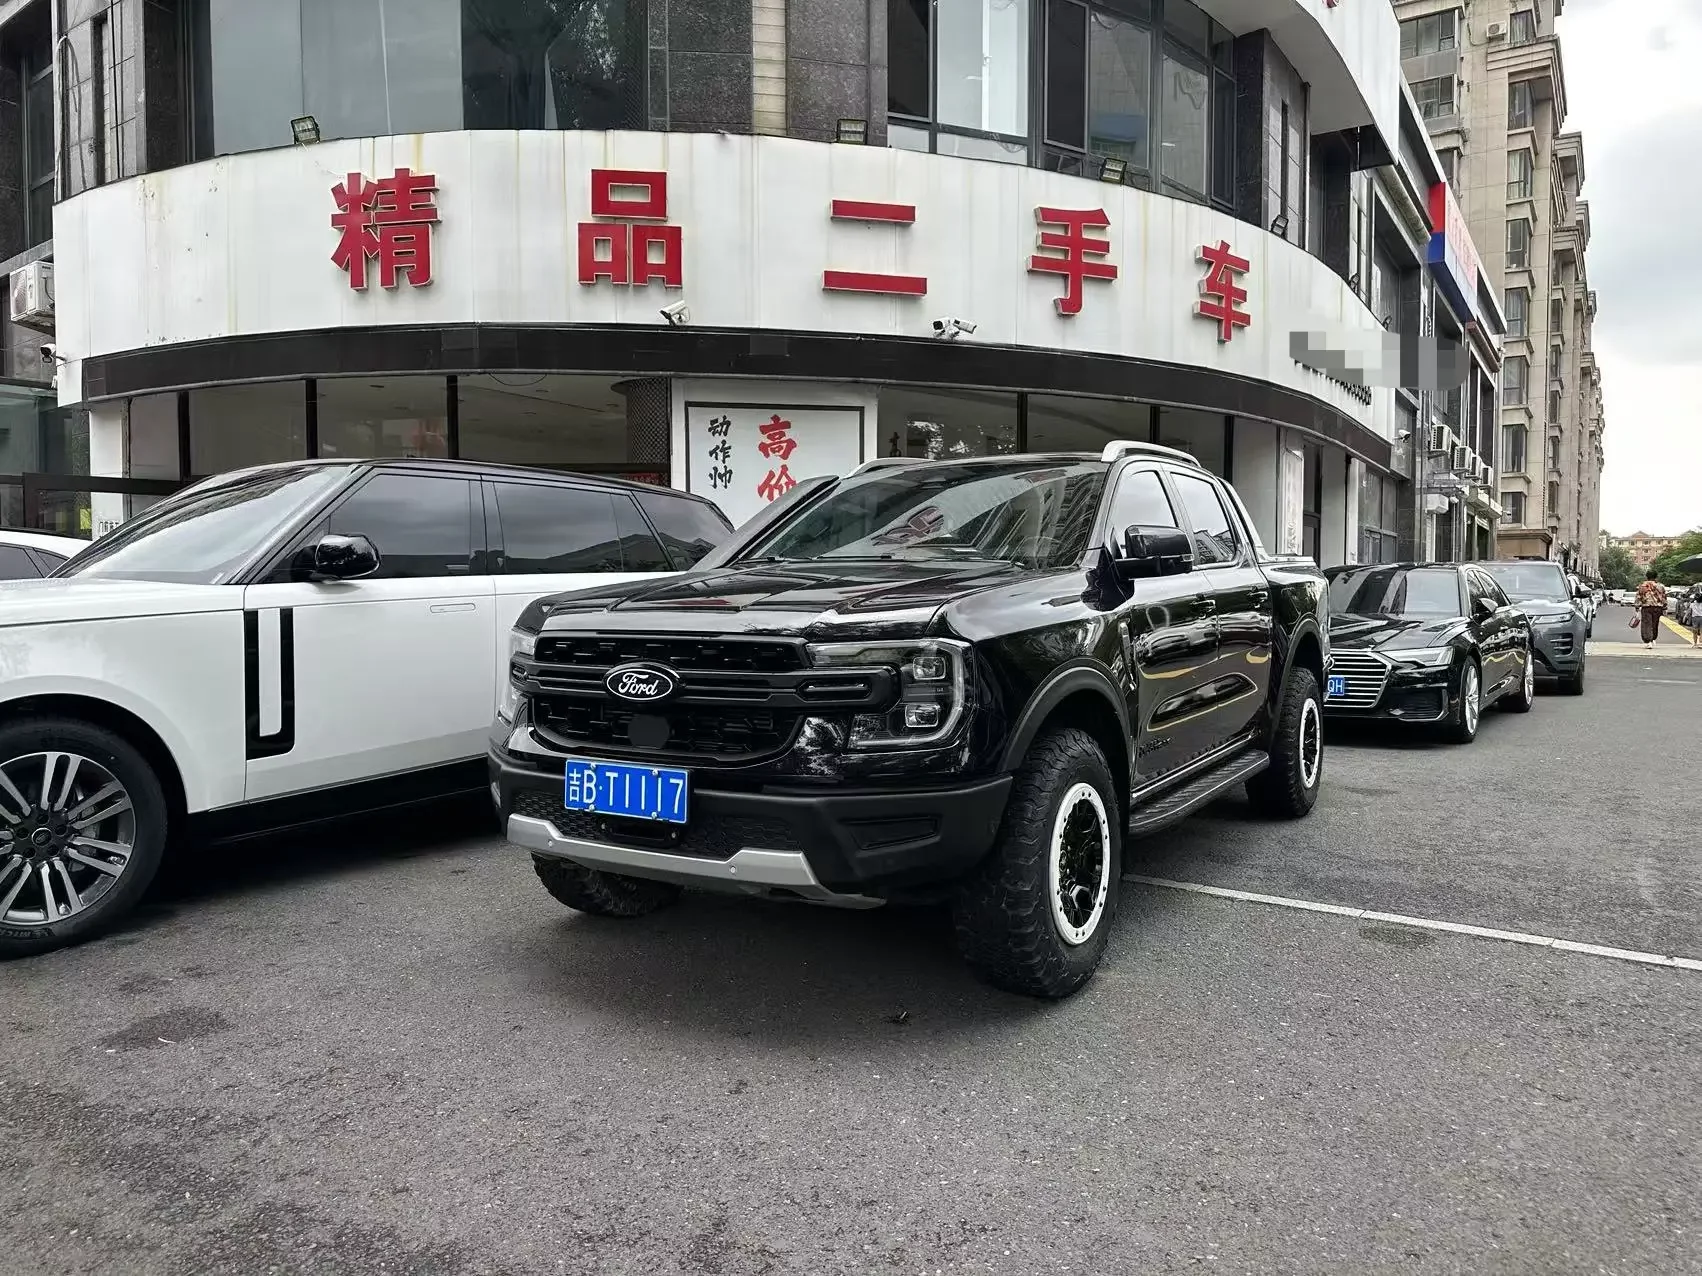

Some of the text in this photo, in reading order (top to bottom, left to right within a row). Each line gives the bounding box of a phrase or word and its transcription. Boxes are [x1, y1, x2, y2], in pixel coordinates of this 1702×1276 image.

[331, 168, 1250, 341] 精品二手车
[708, 415, 733, 489] 动作帅
[618, 672, 659, 696] Ford
